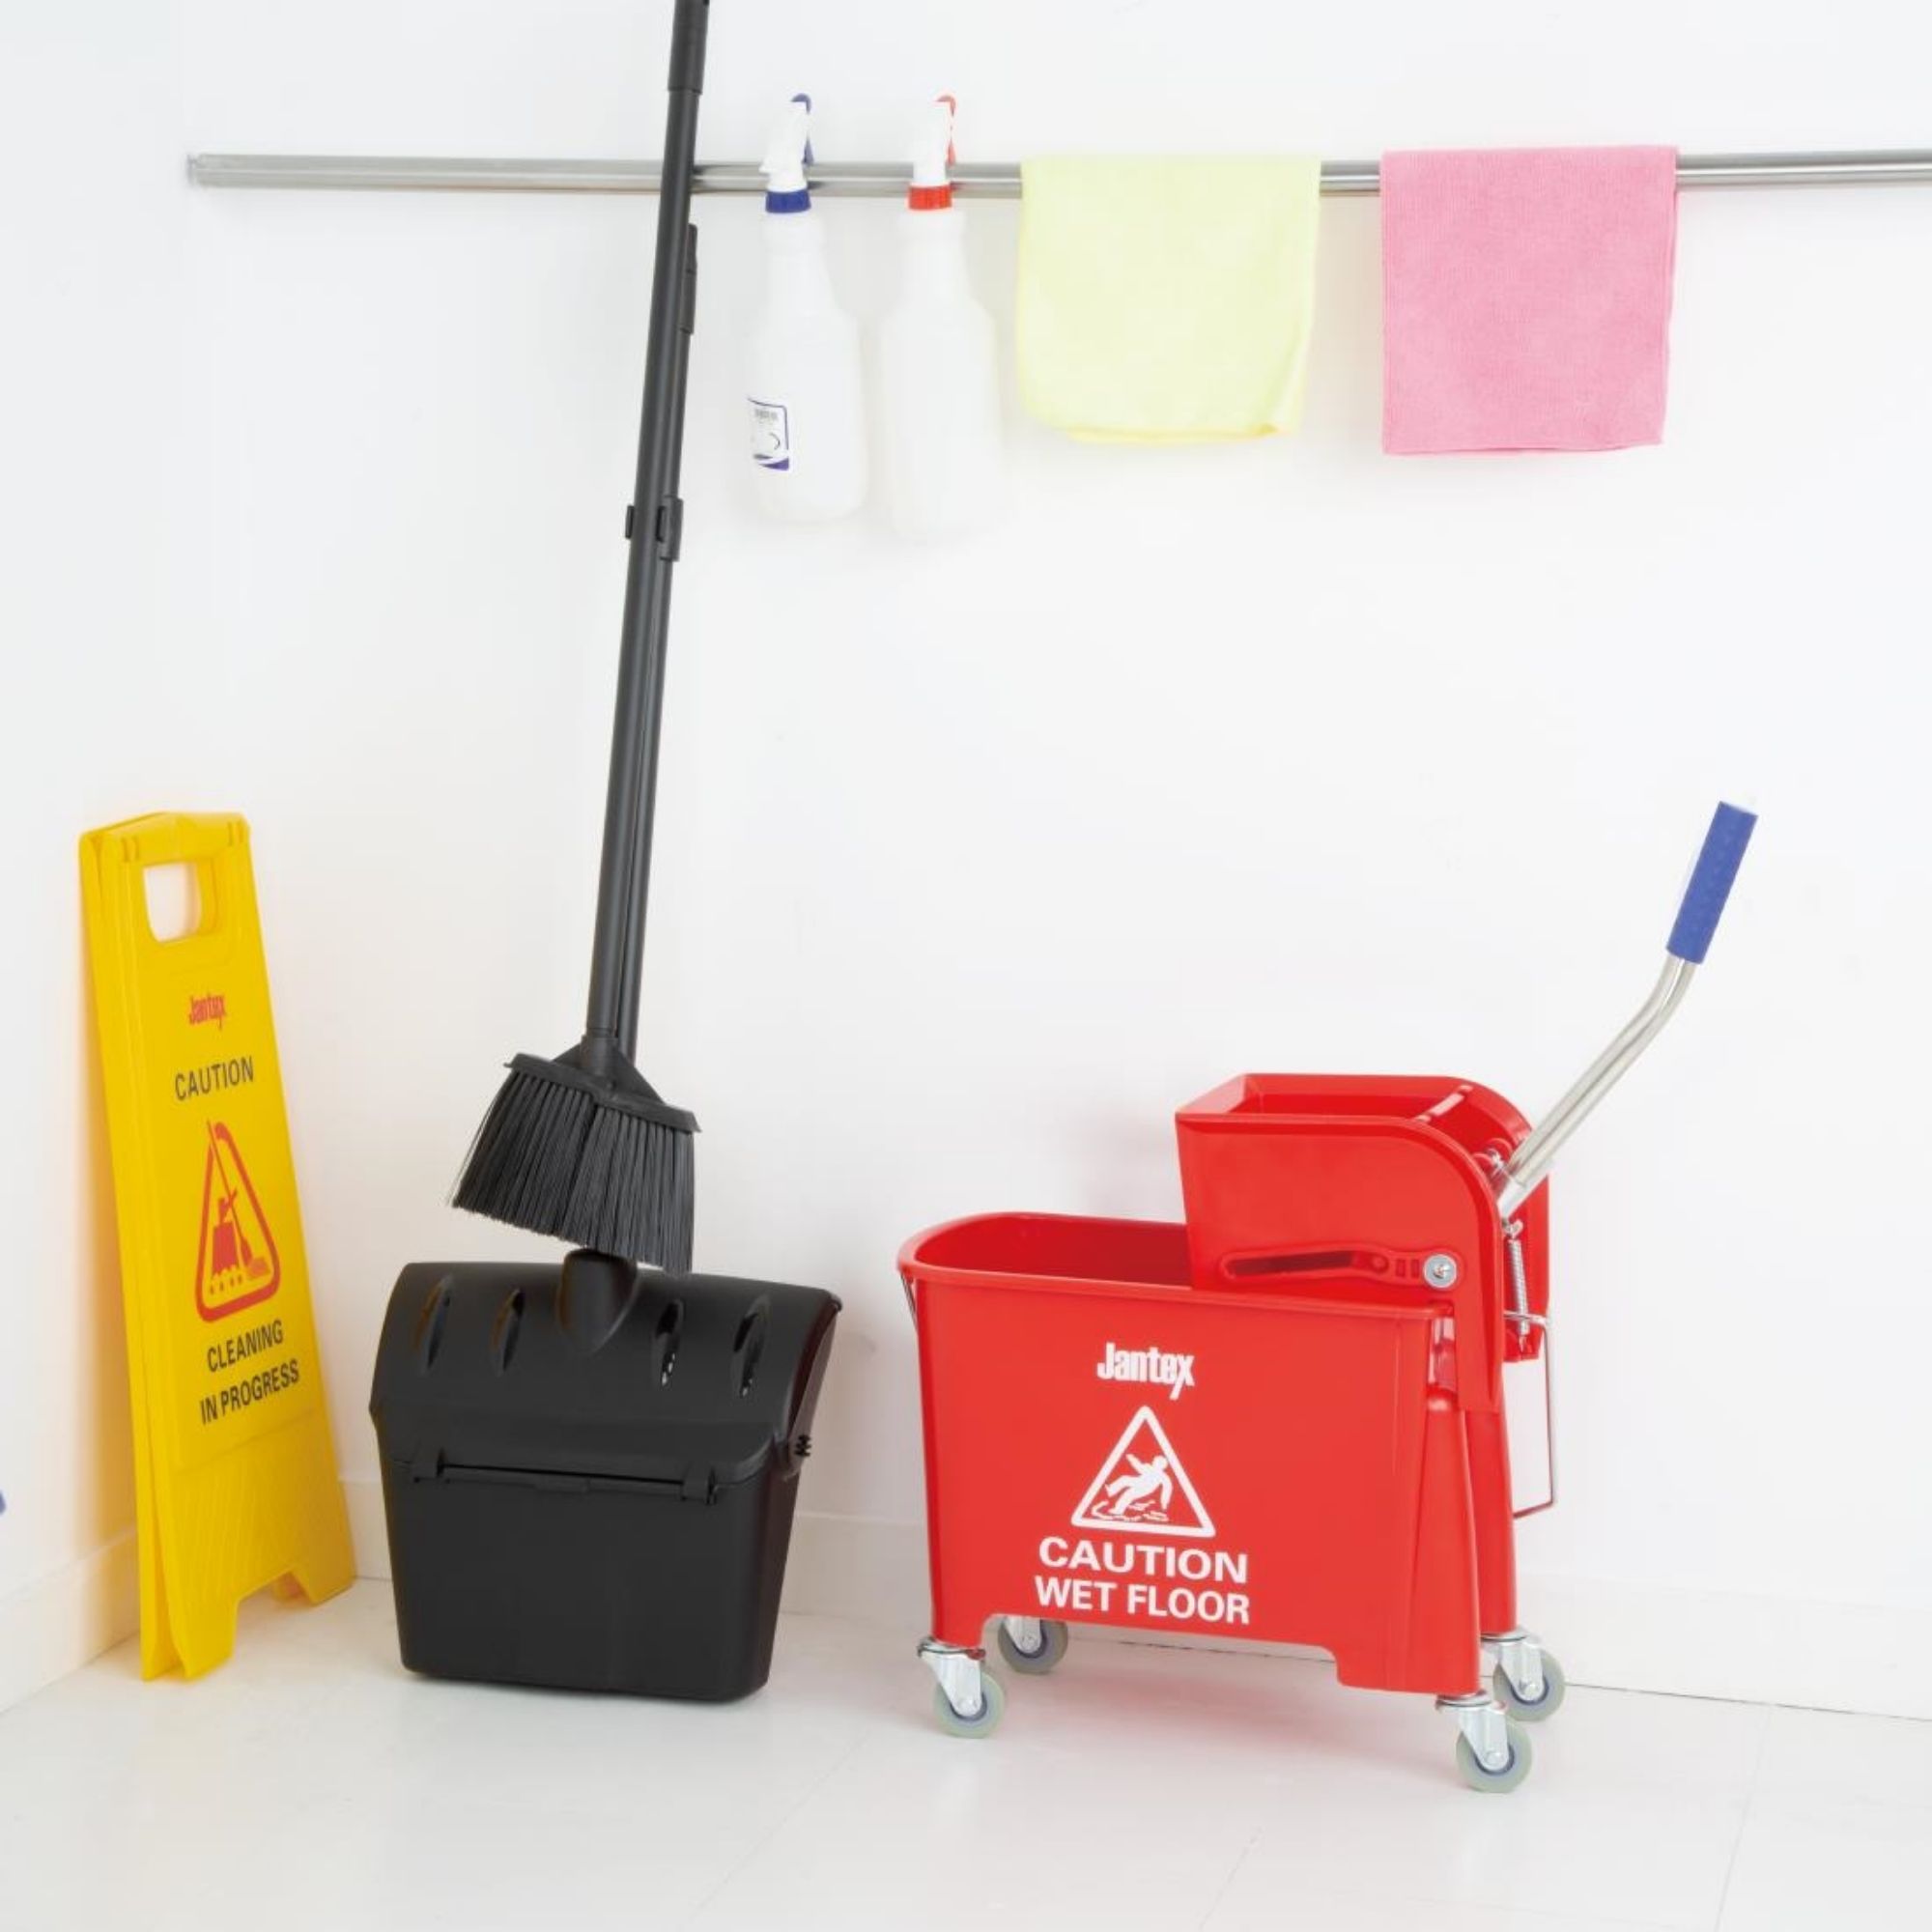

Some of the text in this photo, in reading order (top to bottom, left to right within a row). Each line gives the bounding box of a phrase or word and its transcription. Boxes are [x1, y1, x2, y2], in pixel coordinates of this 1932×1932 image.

[175, 1055, 253, 1101] CAUTION
[207, 1319, 283, 1372] CLEANING
[1096, 1342, 1195, 1400] Jantex
[200, 1358, 299, 1425] IN PROGRESS
[1038, 1536, 1248, 1583] CAUTION
[1034, 1576, 1250, 1625] WET FLOOR
